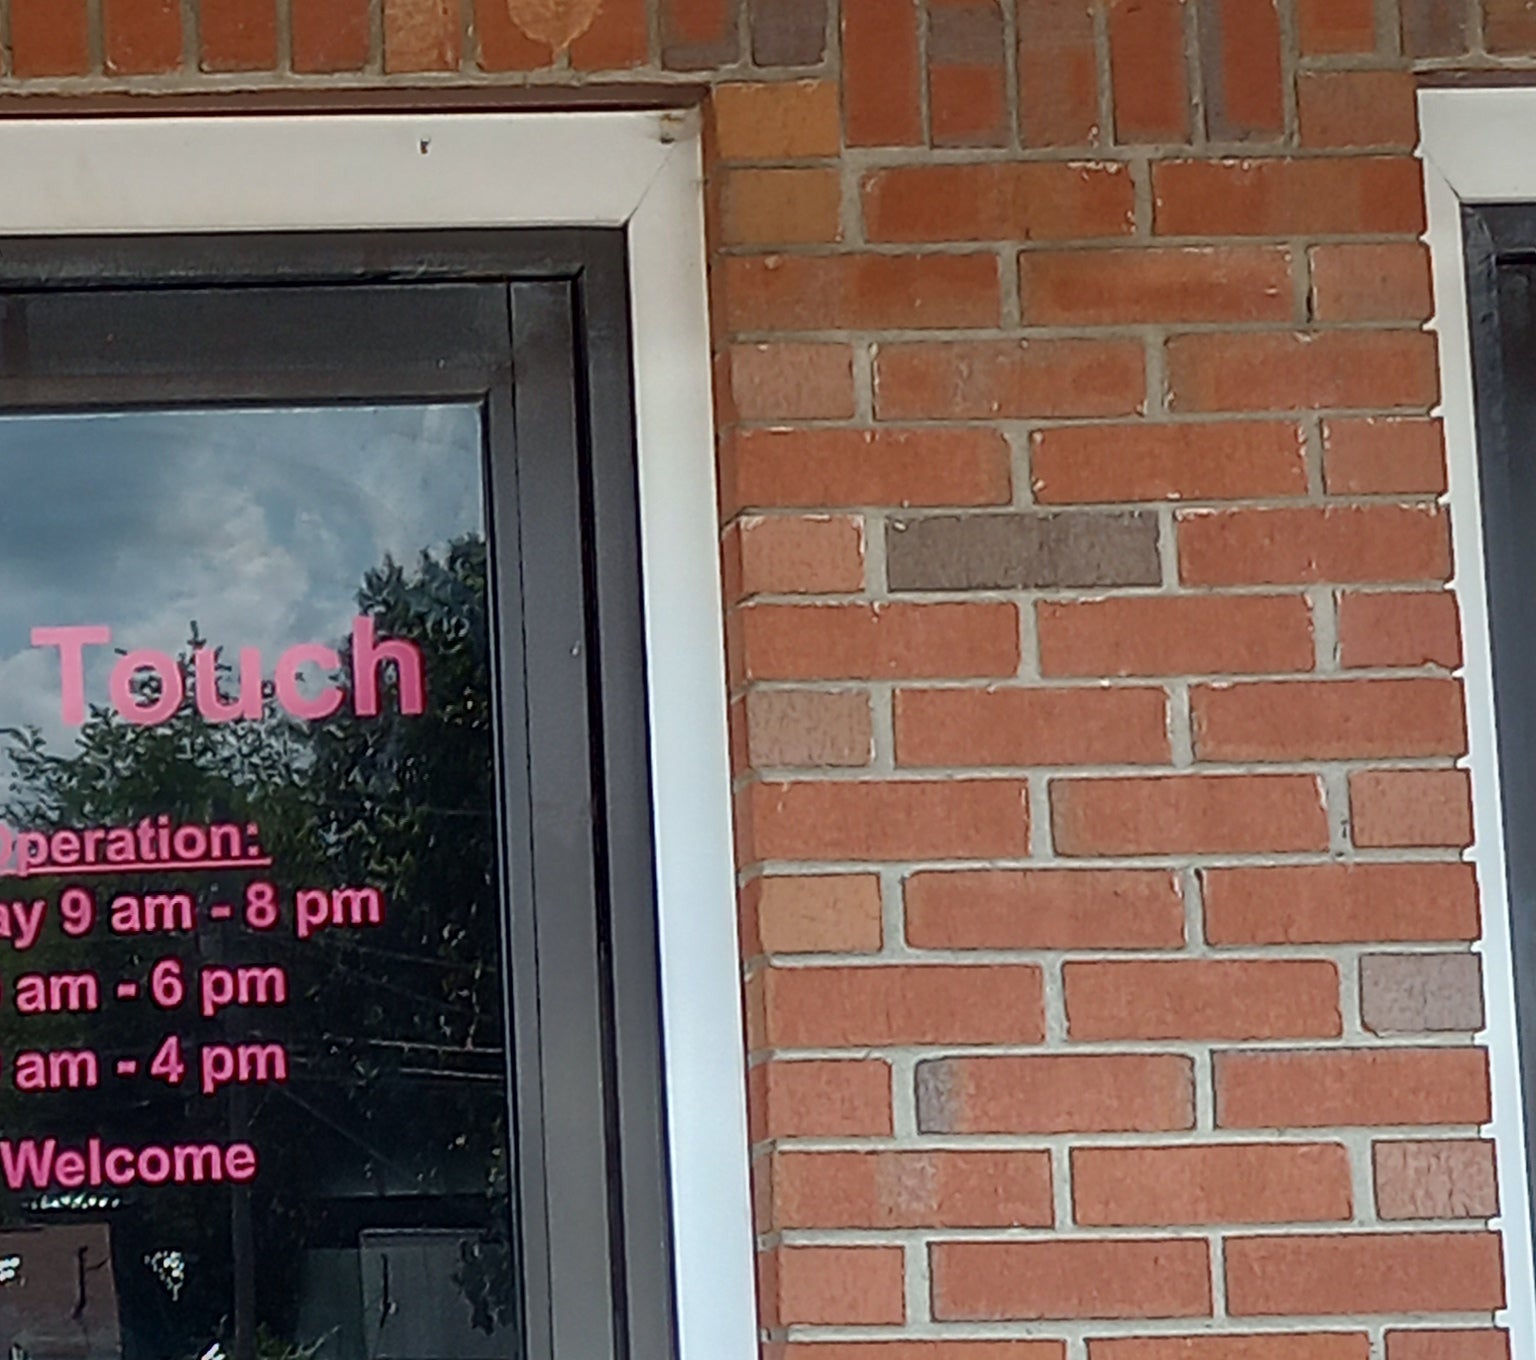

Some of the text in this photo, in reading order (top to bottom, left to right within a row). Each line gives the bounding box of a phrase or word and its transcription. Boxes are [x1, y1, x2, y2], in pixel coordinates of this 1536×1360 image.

[30, 615, 423, 727] Touch
[60, 888, 93, 935] 9
[110, 893, 193, 933] am
[245, 882, 278, 928] 8
[295, 887, 381, 938] pm
[16, 974, 98, 1012] am
[151, 959, 184, 1007] 6
[201, 966, 286, 1017] pm
[15, 1050, 98, 1090] am
[150, 1035, 185, 1083] 4
[201, 1044, 287, 1094] pm
